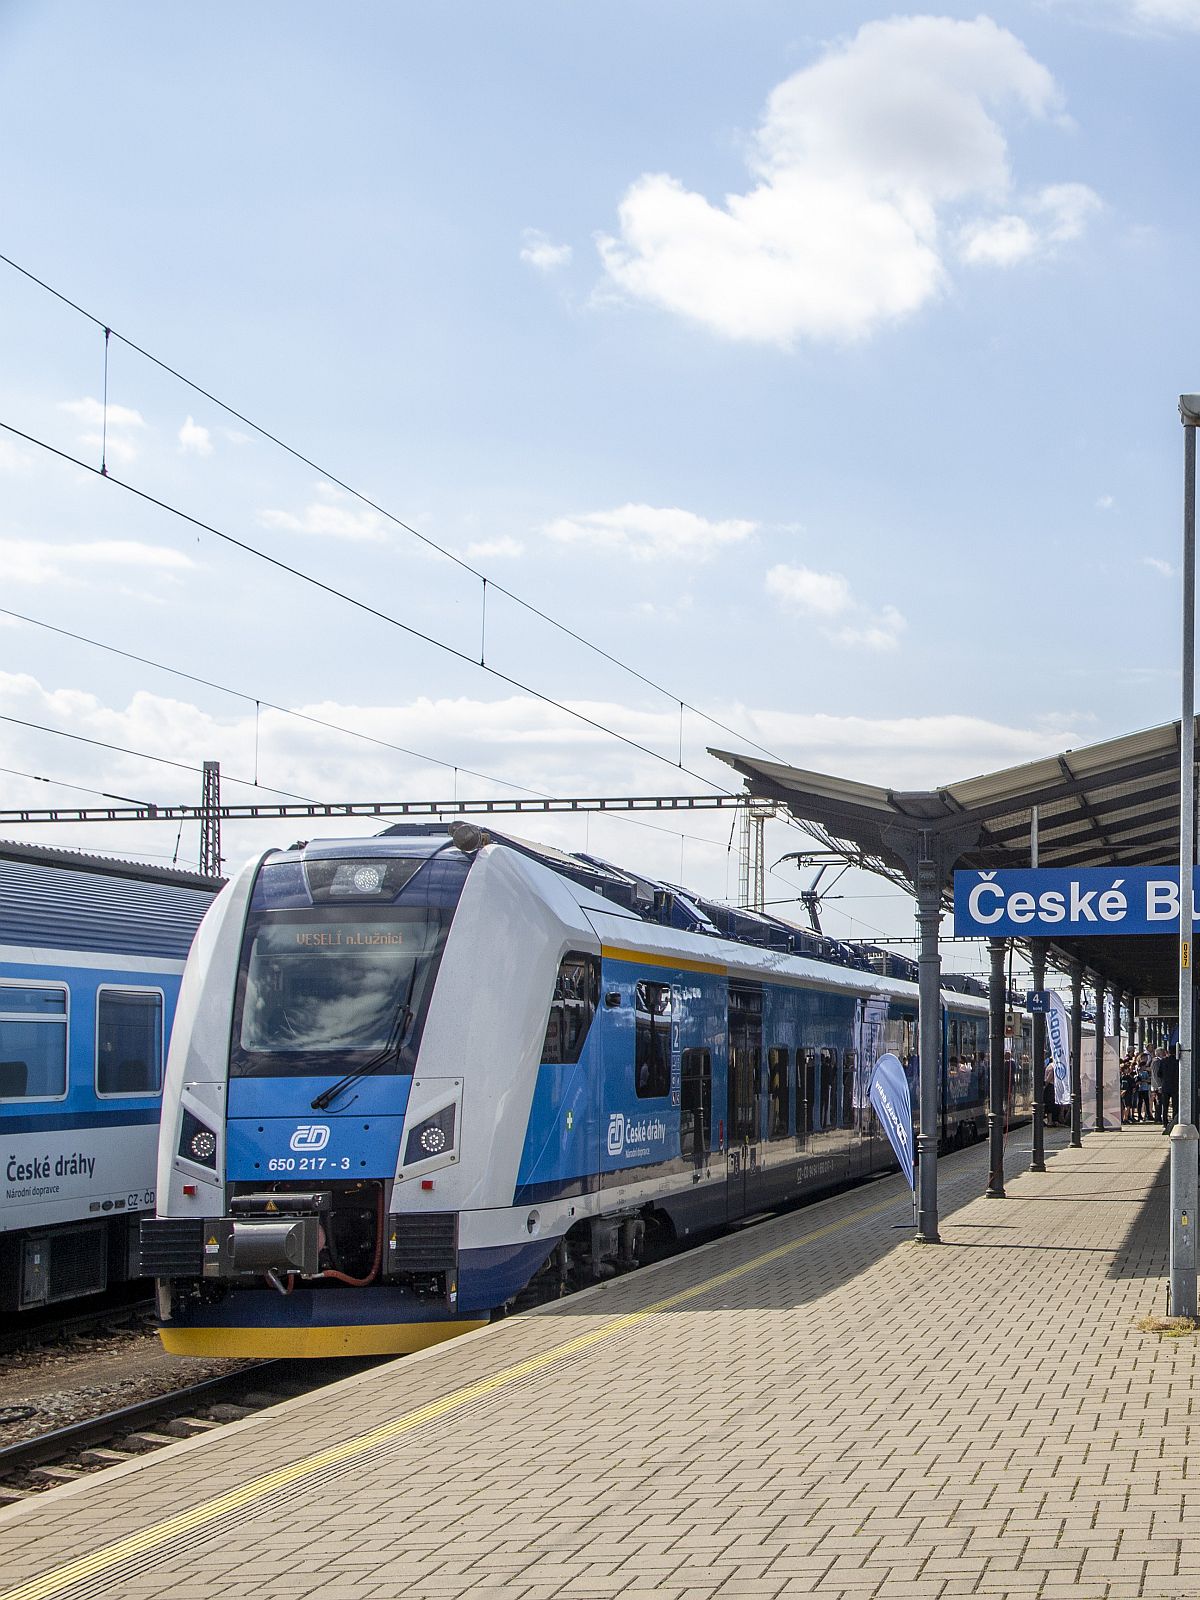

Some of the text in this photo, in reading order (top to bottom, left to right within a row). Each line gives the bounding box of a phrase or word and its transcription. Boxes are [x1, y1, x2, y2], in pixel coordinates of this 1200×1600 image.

[968, 871, 1128, 925] České
[1032, 993, 1043, 1004] 4.
[626, 1118, 646, 1144] České
[647, 1118, 666, 1144] dráhy
[6, 1152, 96, 1182] České dráhy
[268, 1158, 295, 1171] 650
[299, 1157, 327, 1170] 217
[340, 1157, 350, 1170] 3
[6, 1185, 60, 1199] Národní dopravce
